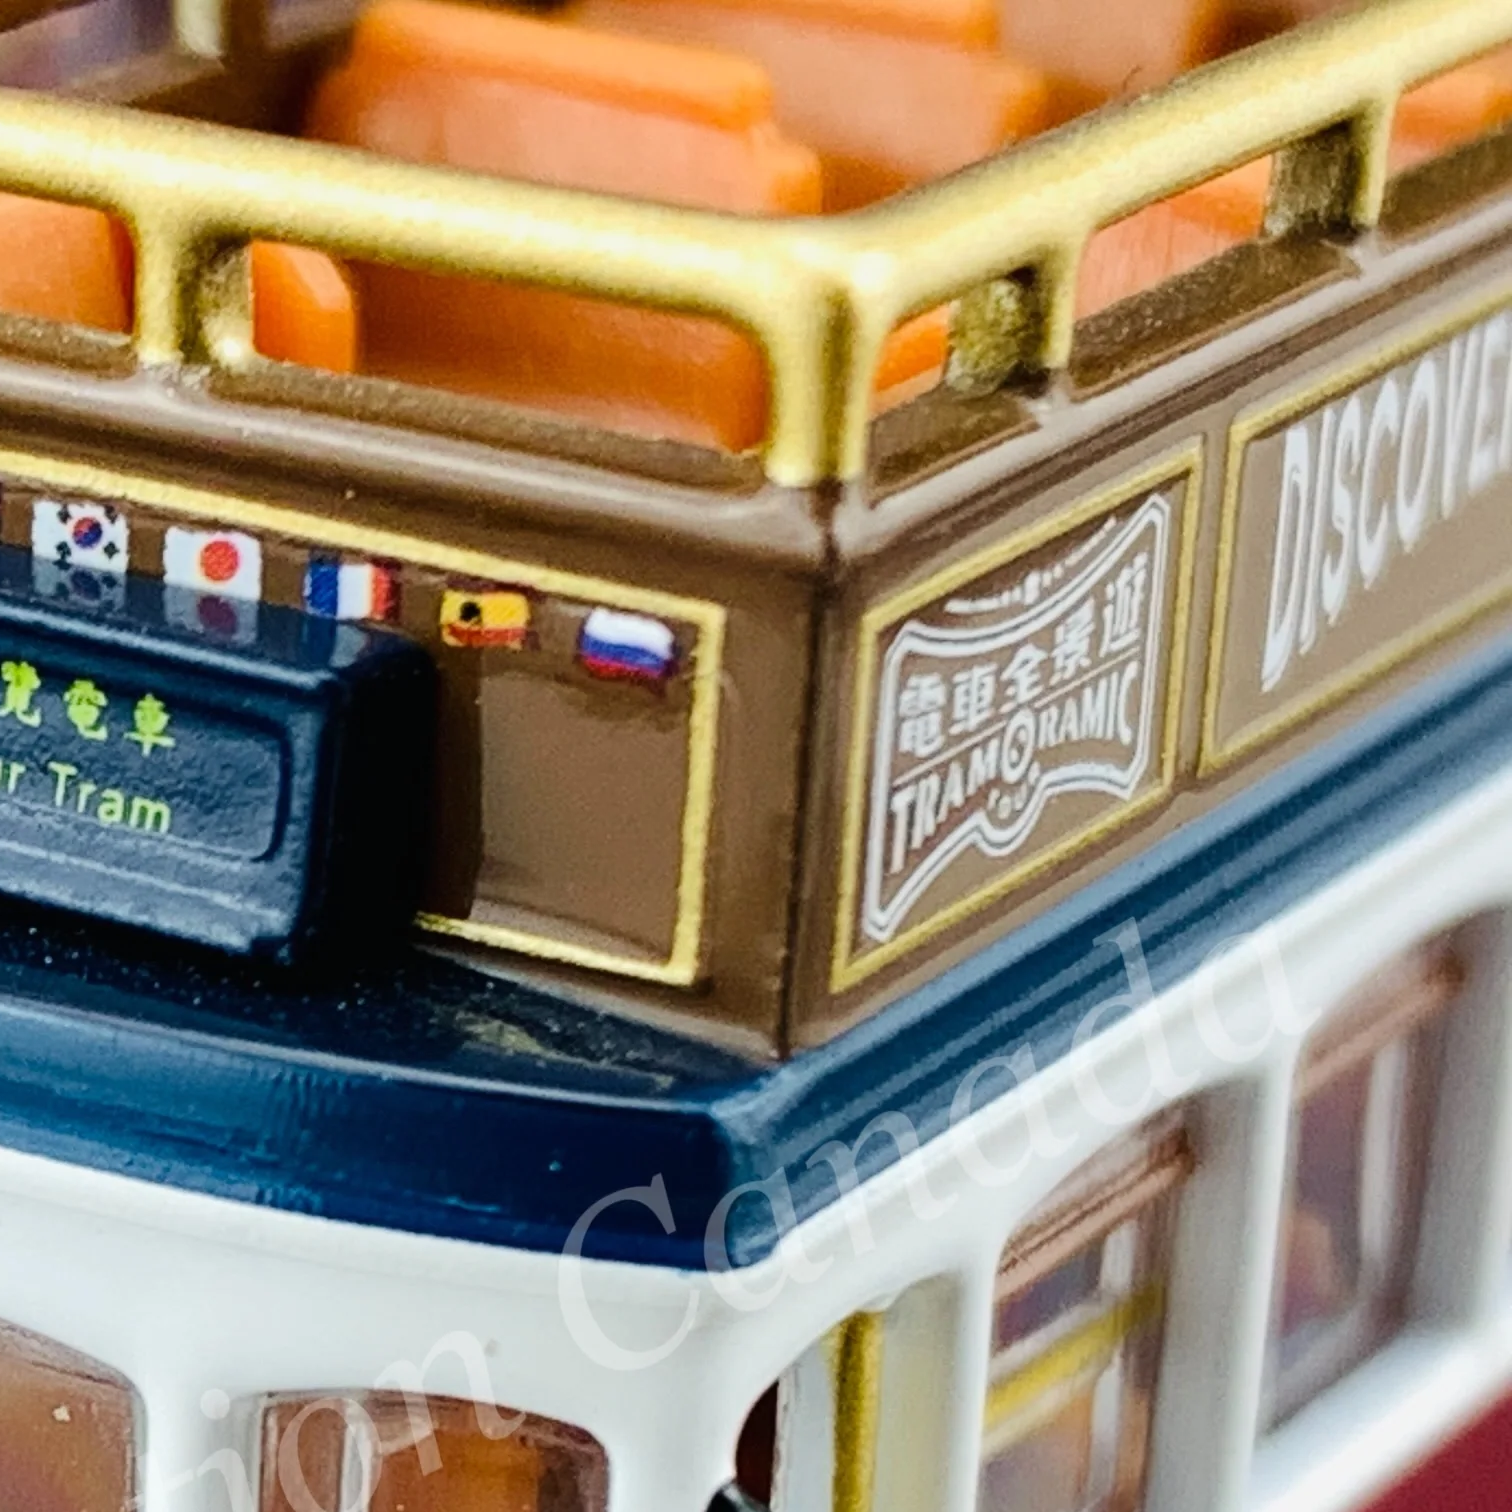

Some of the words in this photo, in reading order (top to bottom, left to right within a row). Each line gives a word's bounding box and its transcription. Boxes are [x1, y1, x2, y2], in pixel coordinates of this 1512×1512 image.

[1262, 308, 1512, 693] DISCOVE
[897, 551, 1148, 759] 電車全景遊
[48, 761, 172, 836] Tram
[889, 660, 1138, 875] TRAMORAMIC
